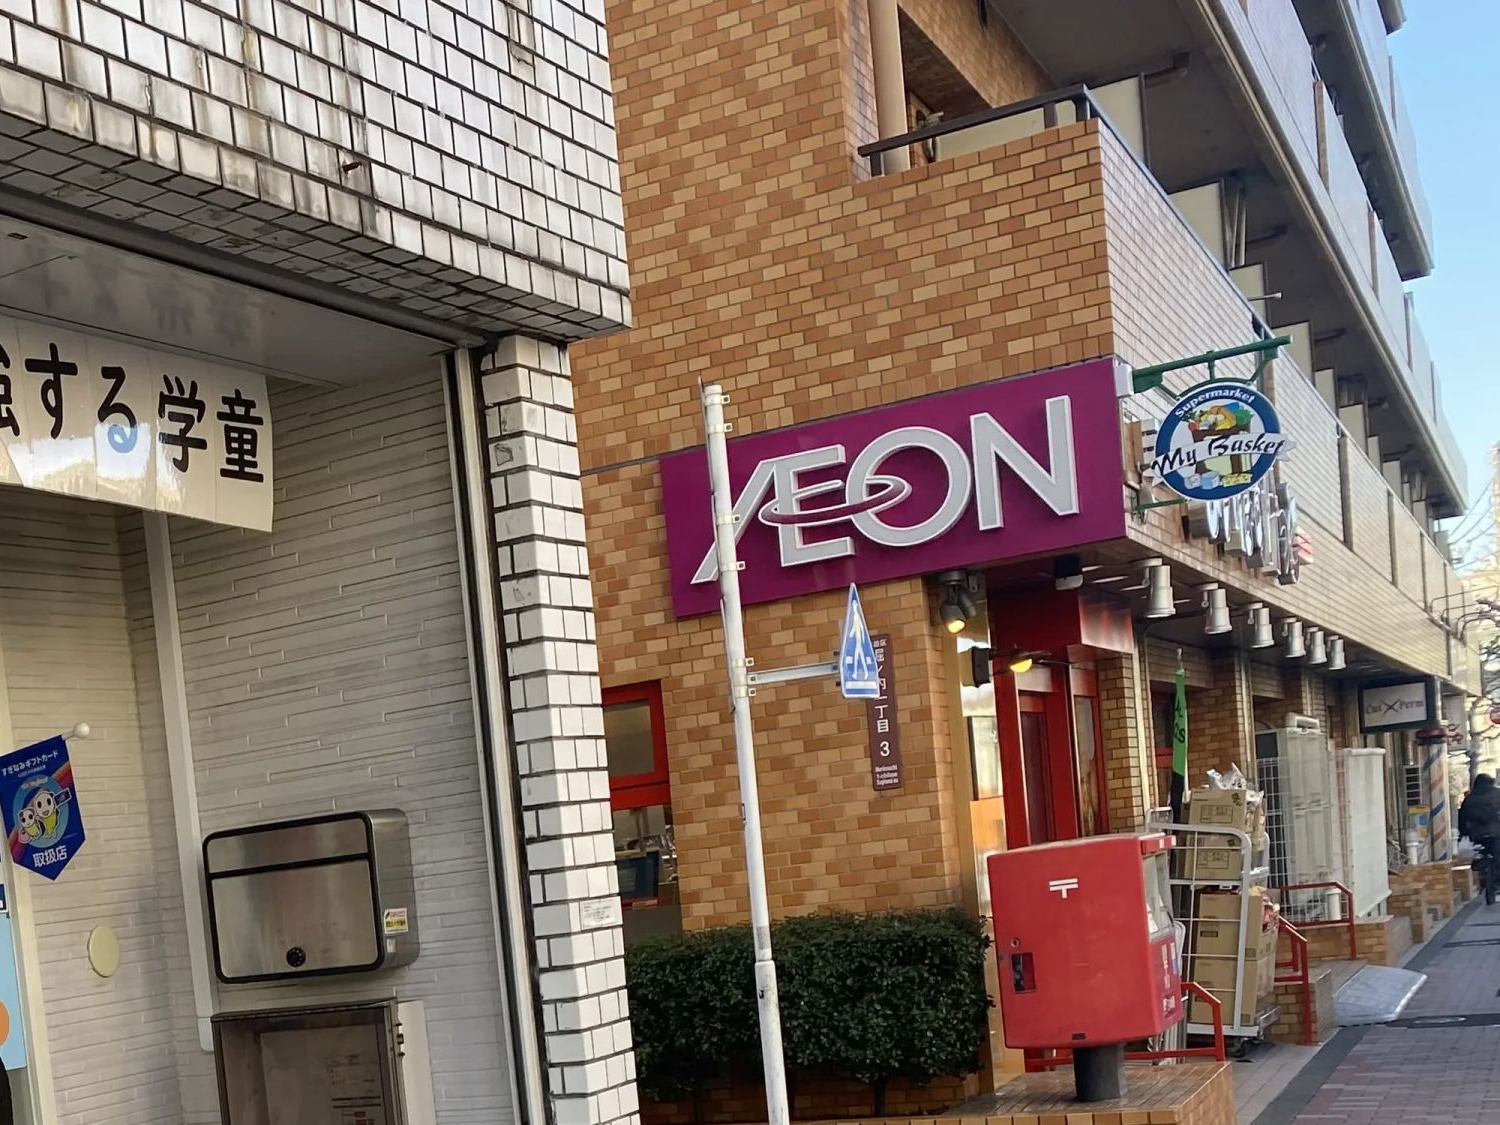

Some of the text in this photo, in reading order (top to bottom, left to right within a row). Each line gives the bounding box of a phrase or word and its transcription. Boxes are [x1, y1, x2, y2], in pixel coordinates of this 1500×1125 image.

[1175, 388, 1255, 418] Supermarket
[1151, 432, 1285, 476] My Basket
[880, 741, 890, 757] 3
[32, 845, 68, 868] 取扱店
